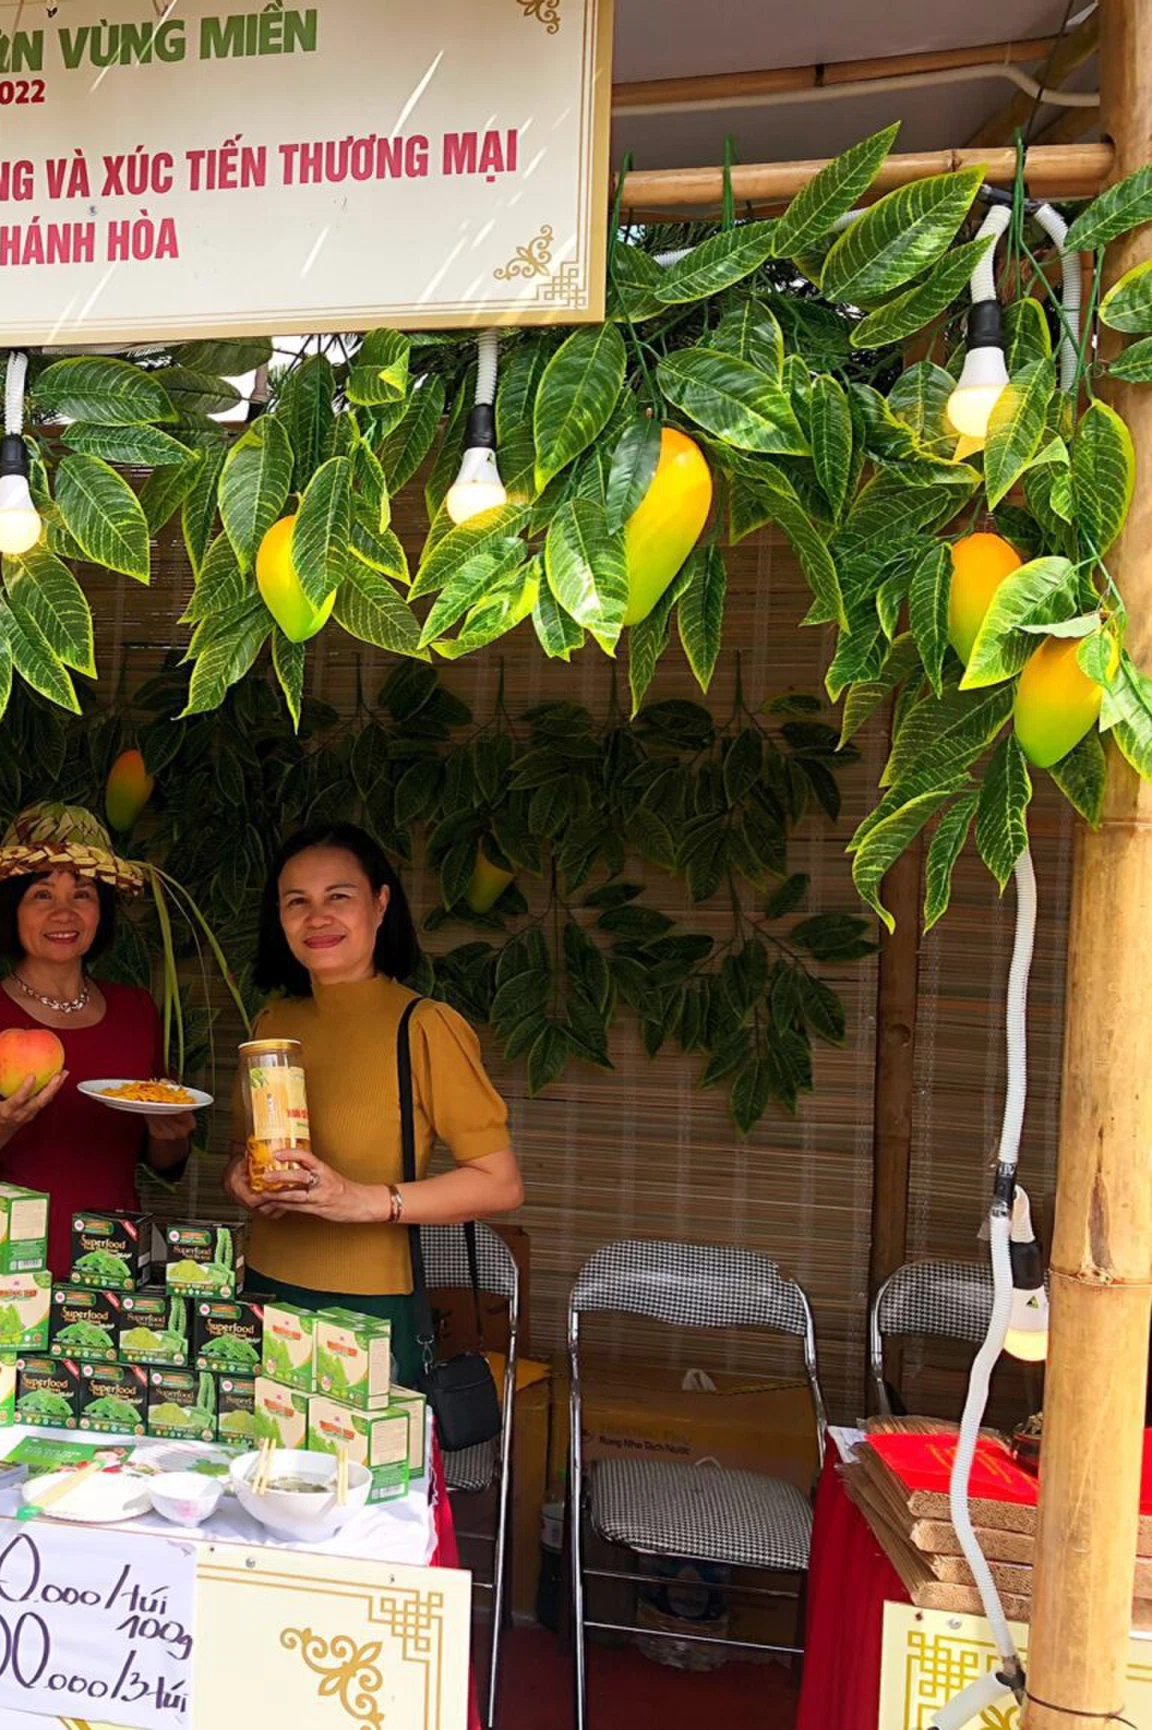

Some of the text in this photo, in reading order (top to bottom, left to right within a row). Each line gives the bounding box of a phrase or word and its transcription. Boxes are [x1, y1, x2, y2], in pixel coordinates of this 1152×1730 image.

[58, 19, 186, 69] VÙNG
[200, 0, 317, 60] MIỀN
[46, 147, 90, 199] VÀ
[101, 144, 174, 196] XÚC
[186, 133, 267, 192] TIẾN
[278, 132, 429, 185] THƯƠNG
[442, 128, 518, 183] MẠI
[107, 208, 179, 262] HÒA
[206, 1319, 254, 1334] Superfood
[89, 1380, 137, 1395] Superfood
[115, 1614, 193, 1661] 100g
